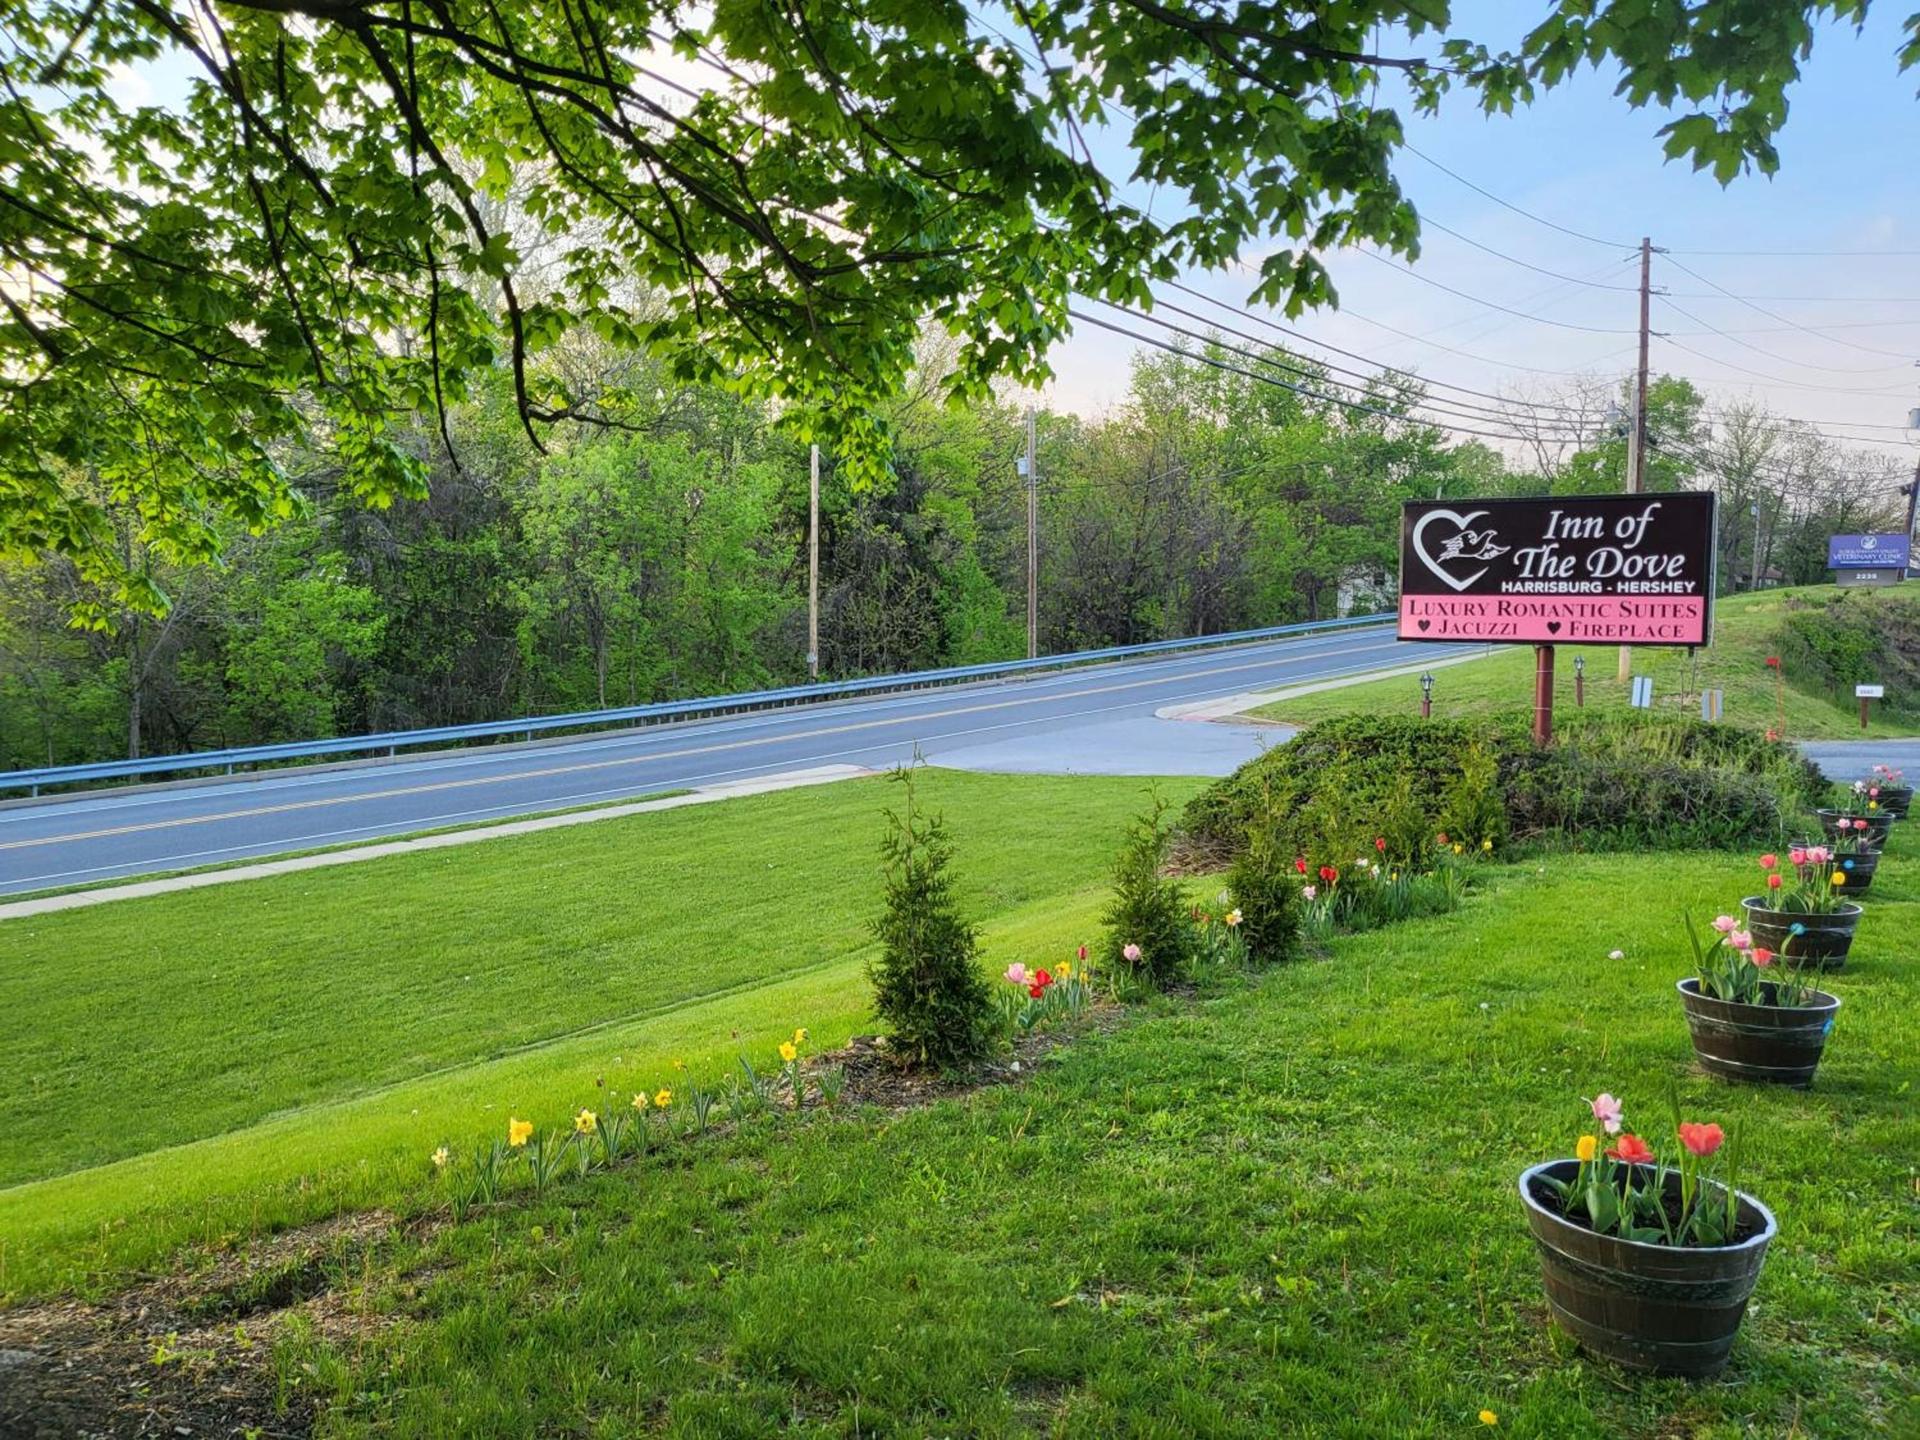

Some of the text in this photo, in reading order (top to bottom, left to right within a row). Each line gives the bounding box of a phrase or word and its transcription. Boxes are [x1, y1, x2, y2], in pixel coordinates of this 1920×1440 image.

[1542, 502, 1662, 549] Inn of
[1513, 543, 1686, 578] The Dove
[1501, 580, 1603, 593] HARRISBURG
[1617, 581, 1696, 594] HERSHEY
